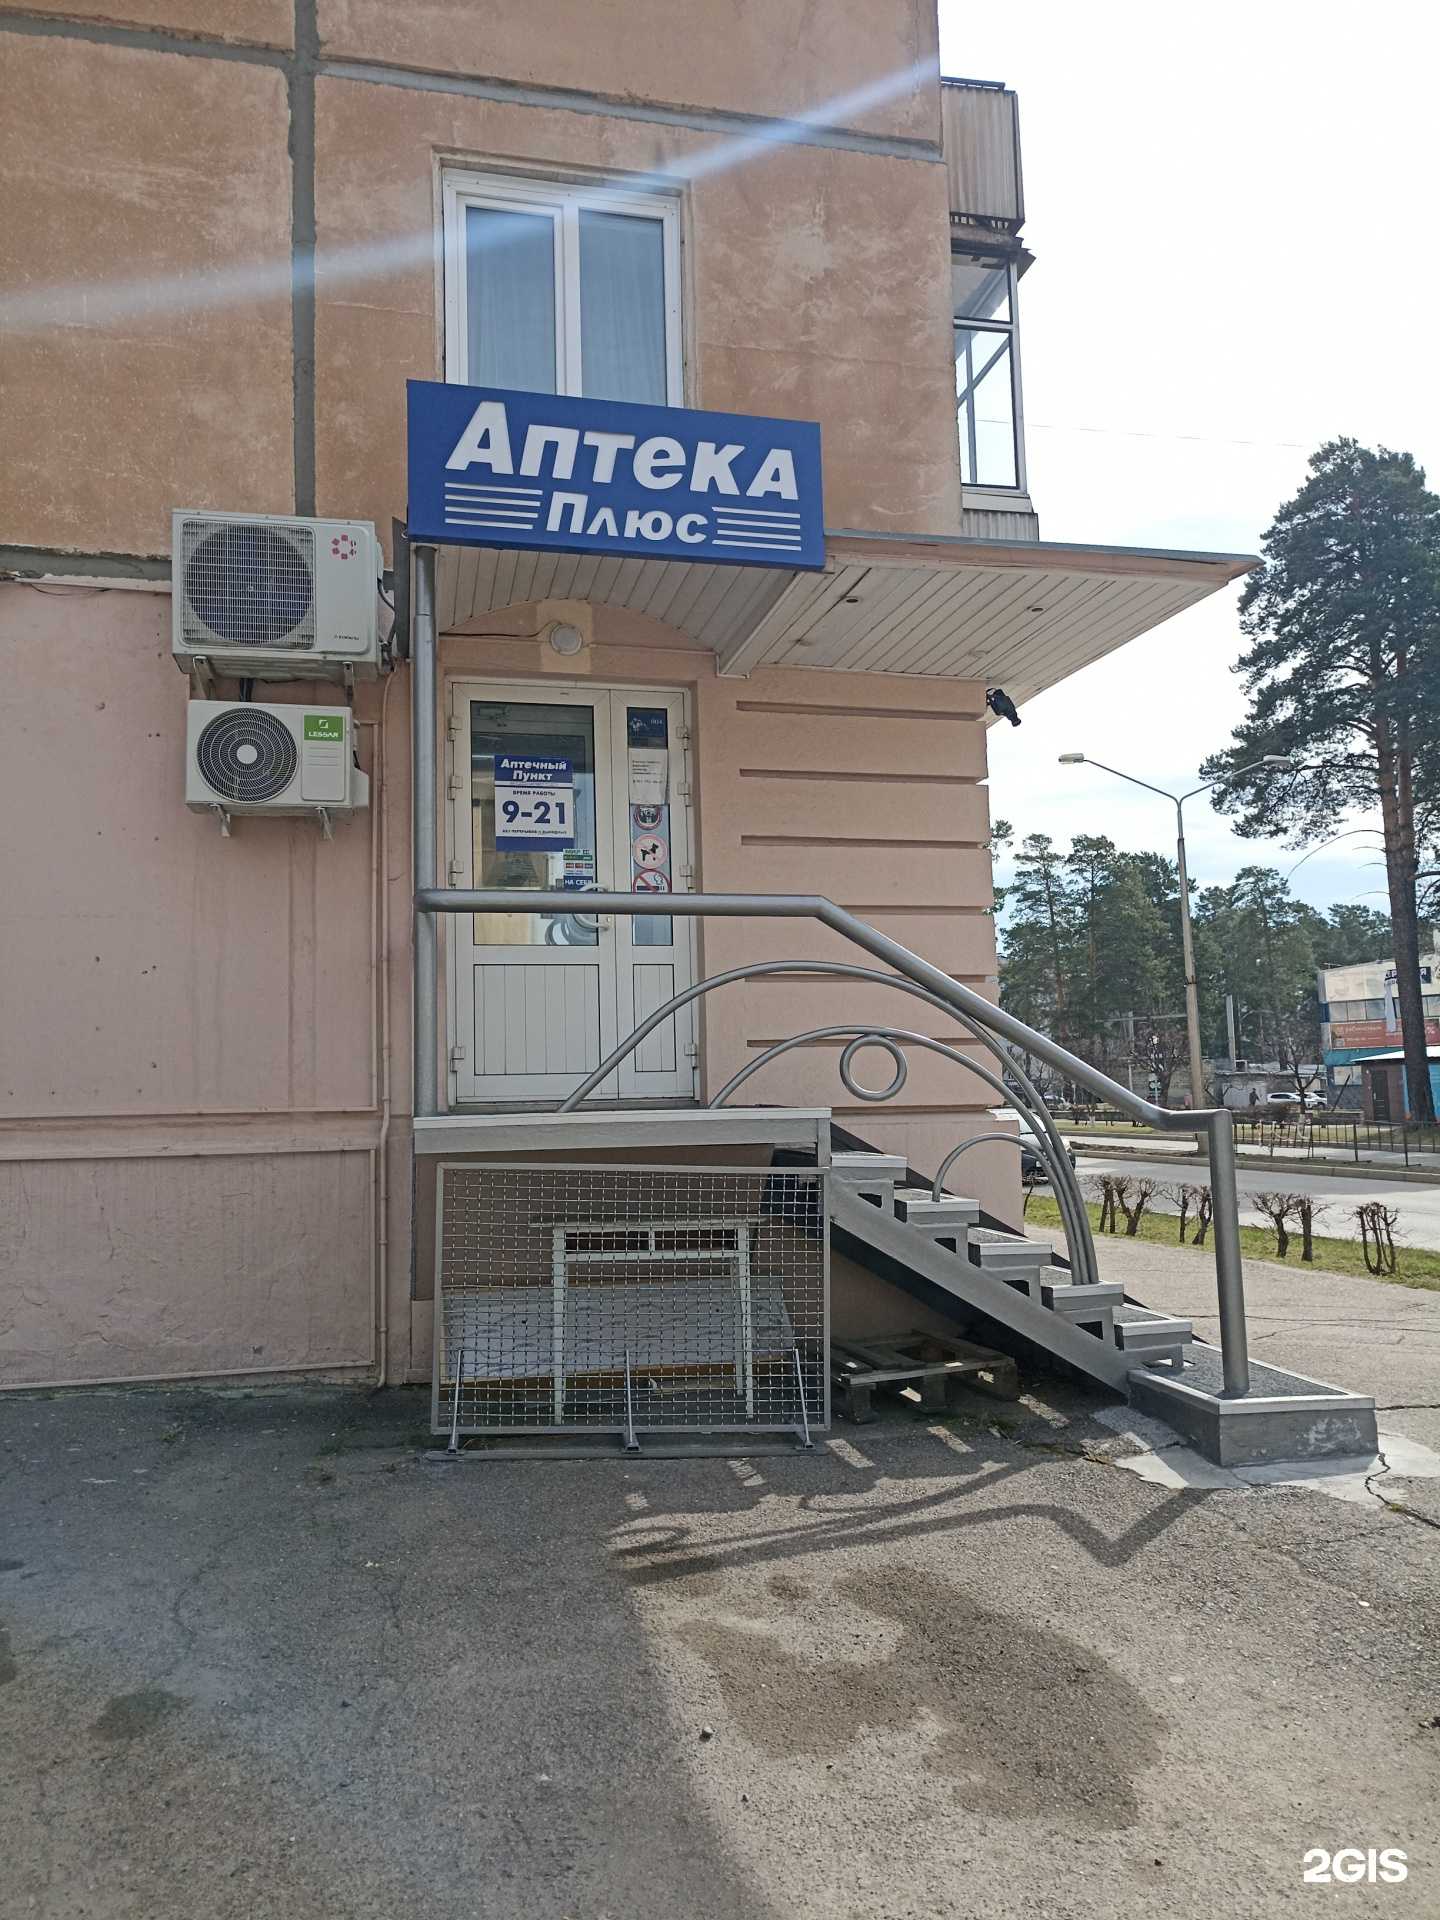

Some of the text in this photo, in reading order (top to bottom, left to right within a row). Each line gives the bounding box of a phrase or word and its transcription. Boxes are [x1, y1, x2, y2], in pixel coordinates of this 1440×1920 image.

[546, 491, 709, 544] Плюс
[501, 758, 567, 770] Аптечный
[512, 770, 553, 783] Пункт
[502, 800, 566, 825] 9-21
